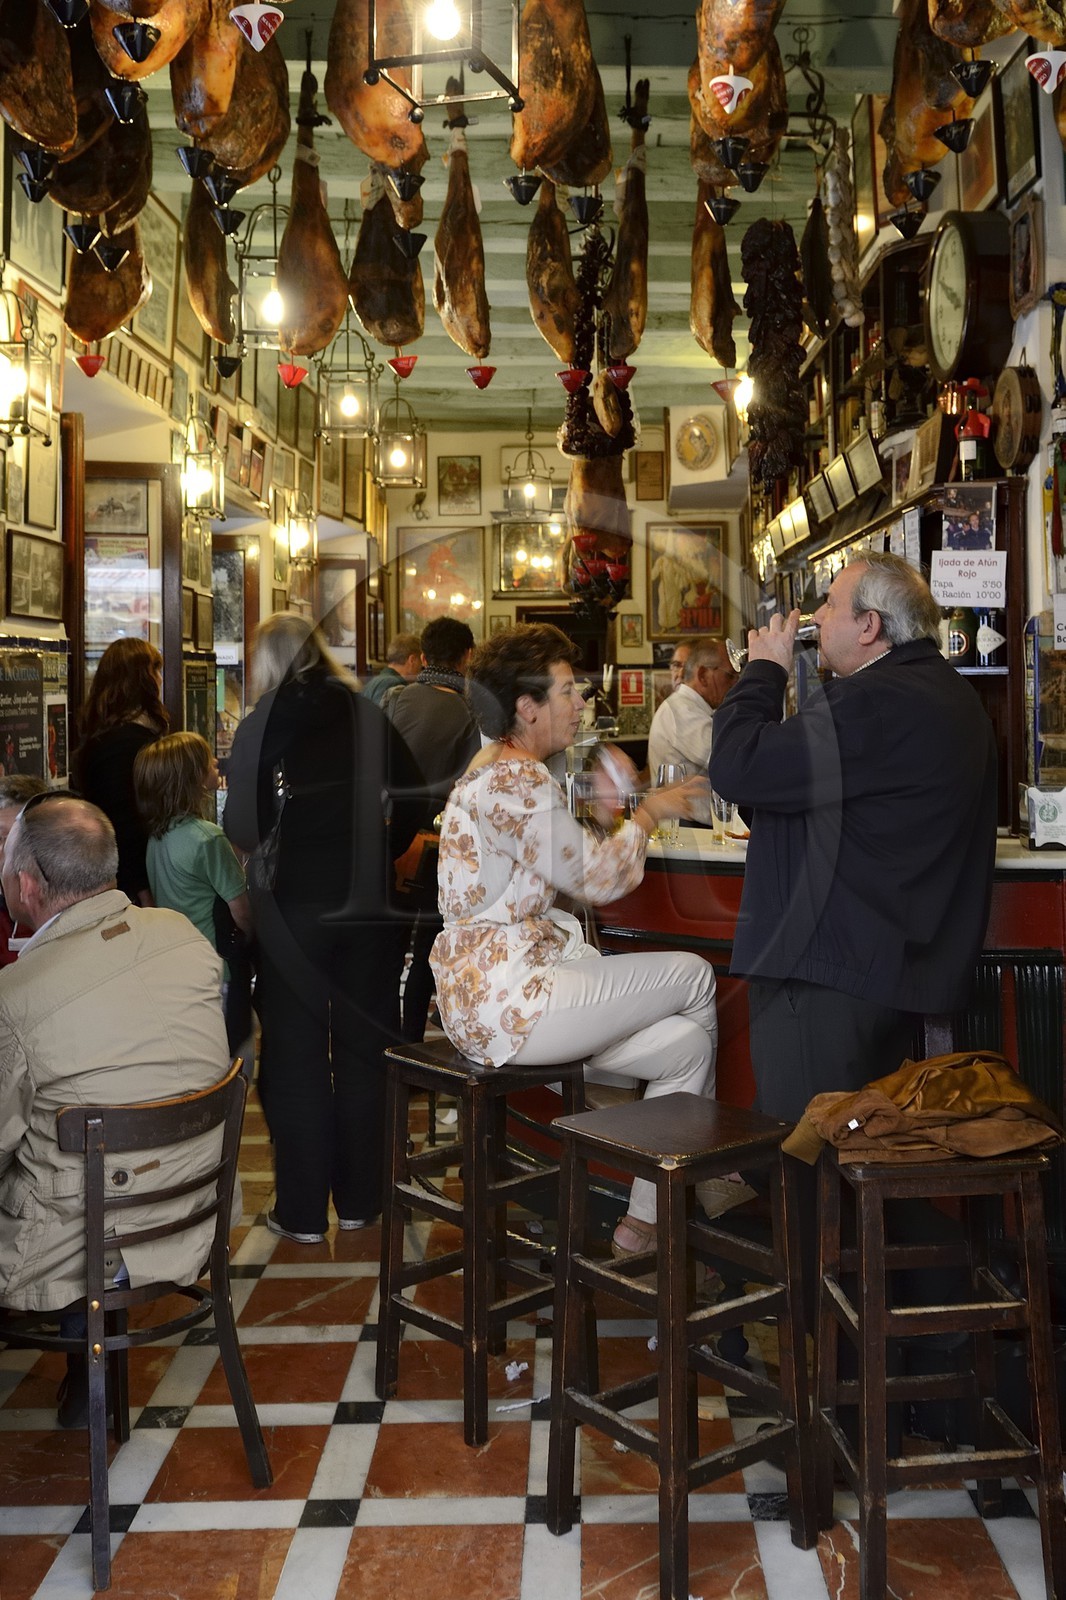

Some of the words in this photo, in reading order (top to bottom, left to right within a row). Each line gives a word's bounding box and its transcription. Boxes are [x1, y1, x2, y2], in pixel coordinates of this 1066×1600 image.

[938, 558, 961, 568] Ijada
[963, 559, 975, 567] de
[977, 558, 998, 567] Atún
[958, 570, 977, 579] Rojo
[932, 580, 954, 588] Tapa
[942, 590, 971, 599] Ración
